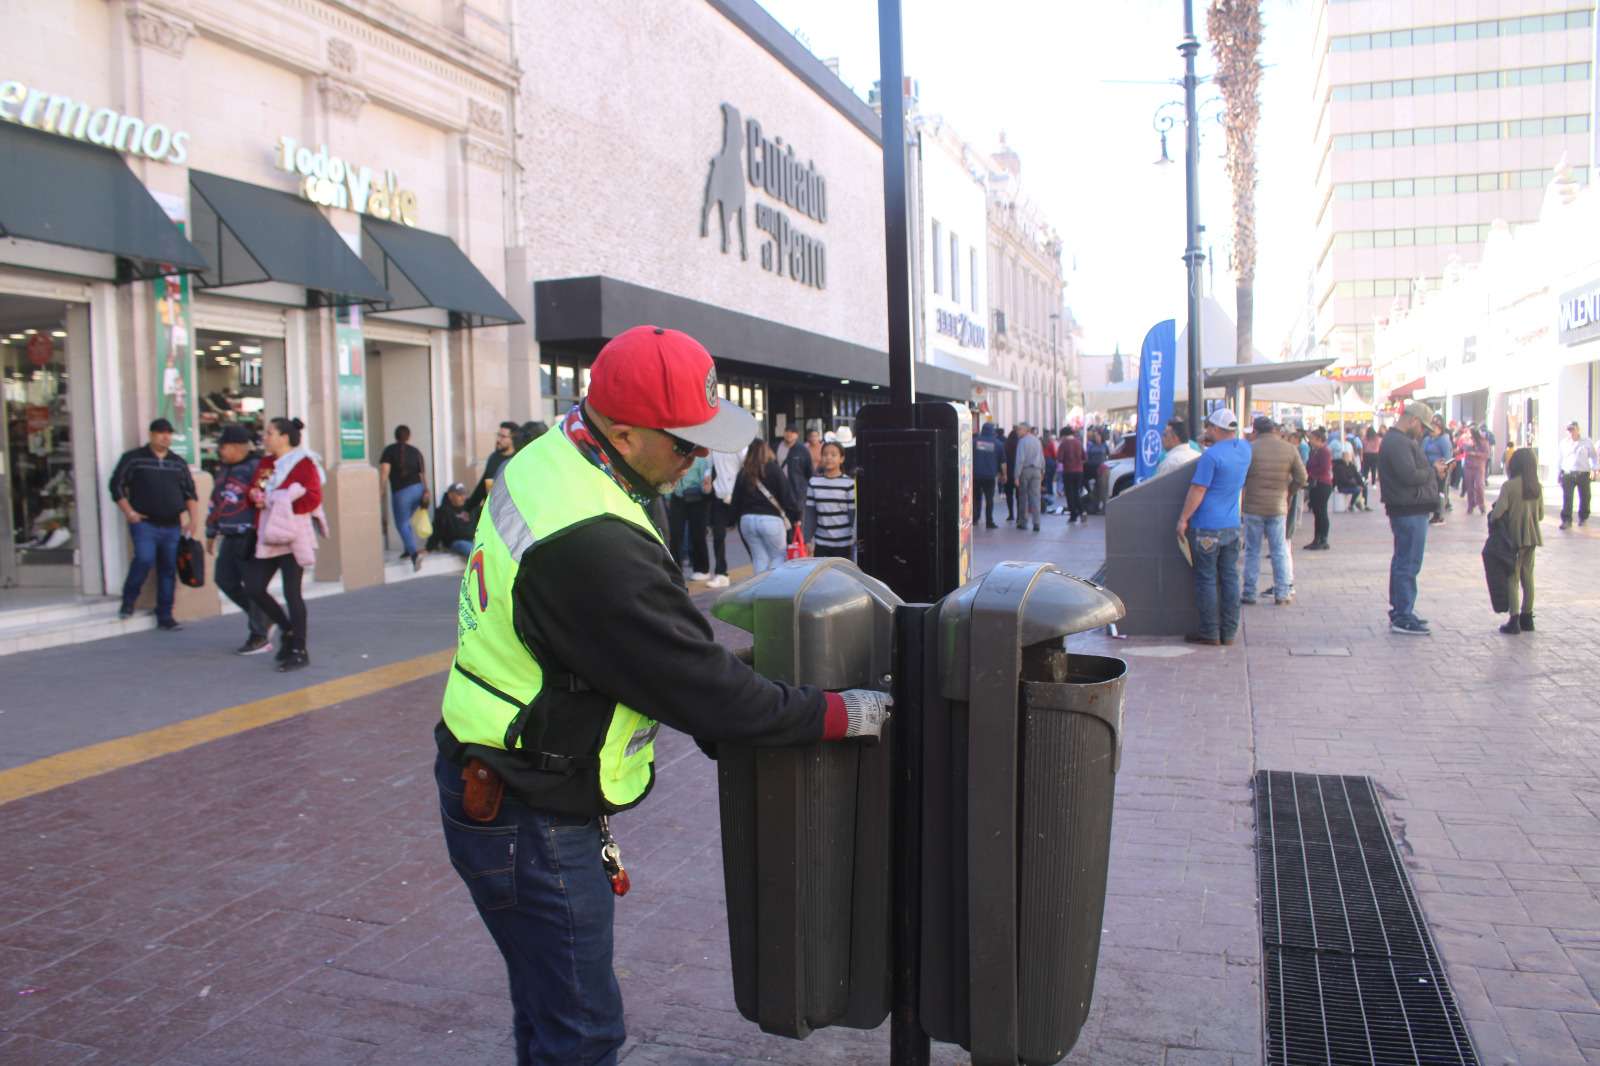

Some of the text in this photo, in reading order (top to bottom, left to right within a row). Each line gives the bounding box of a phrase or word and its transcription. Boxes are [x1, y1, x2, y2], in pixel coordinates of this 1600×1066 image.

[0, 80, 190, 164] ermanos
[278, 135, 345, 183] Todo
[344, 159, 416, 227] Vale
[1149, 351, 1162, 425] SUBARU
